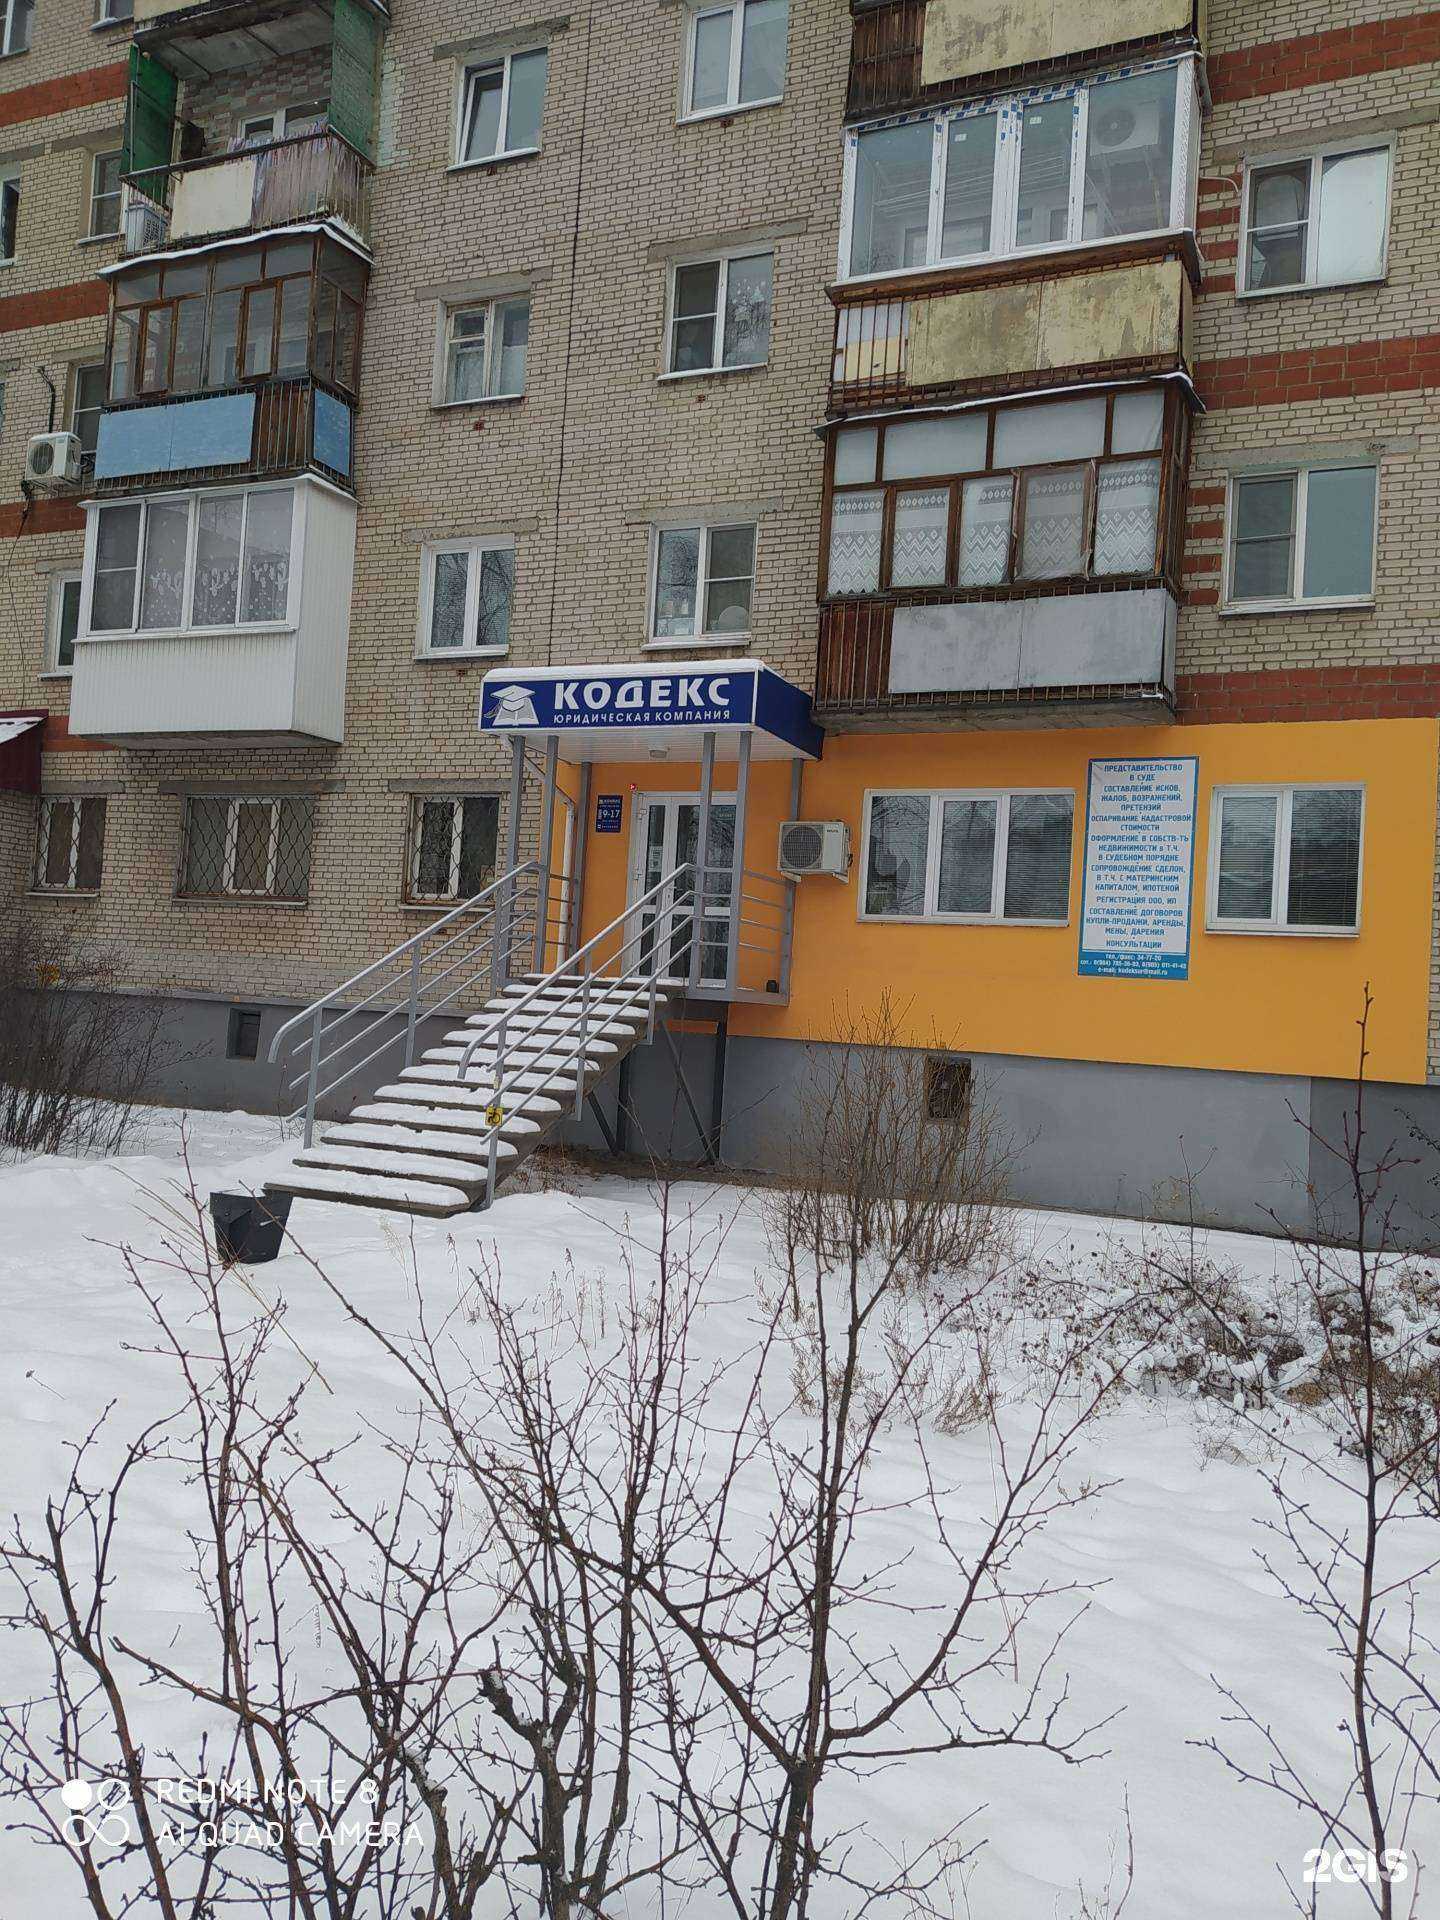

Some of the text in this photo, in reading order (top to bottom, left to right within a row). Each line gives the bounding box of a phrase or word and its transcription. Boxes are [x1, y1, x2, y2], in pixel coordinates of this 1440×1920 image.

[554, 677, 730, 710] КОДЕКС
[553, 710, 731, 724] ЮРИДИЧЕСКАЯ КОМПАНИЯ
[1104, 764, 1183, 772] ПРЕДСТАВИТЕЛЬСТВО
[1131, 794, 1183, 802] ВОЗРАЖЕНИЙ,
[1120, 803, 1161, 811] ПРЕТЕНЗИЙ
[1141, 814, 1192, 823] КАДАСТРОВОЙ
[1105, 854, 1143, 862] СУДЕБНОМ
[1147, 854, 1180, 862] ПОРЯДКЕ
[1091, 865, 1186, 873] СОПРОВОЖДЕНИЕ СДЕЛОК,
[1143, 884, 1180, 892] ИПОТЕКОЙ
[1096, 896, 1146, 904] РЕГИСТРАЦИЯ
[1152, 919, 1186, 928] АРЕНДЫ,
[1131, 928, 1165, 936] ДАРЕНИЯ
[1106, 940, 1162, 949] КОНСУЛЬТАЦИИ
